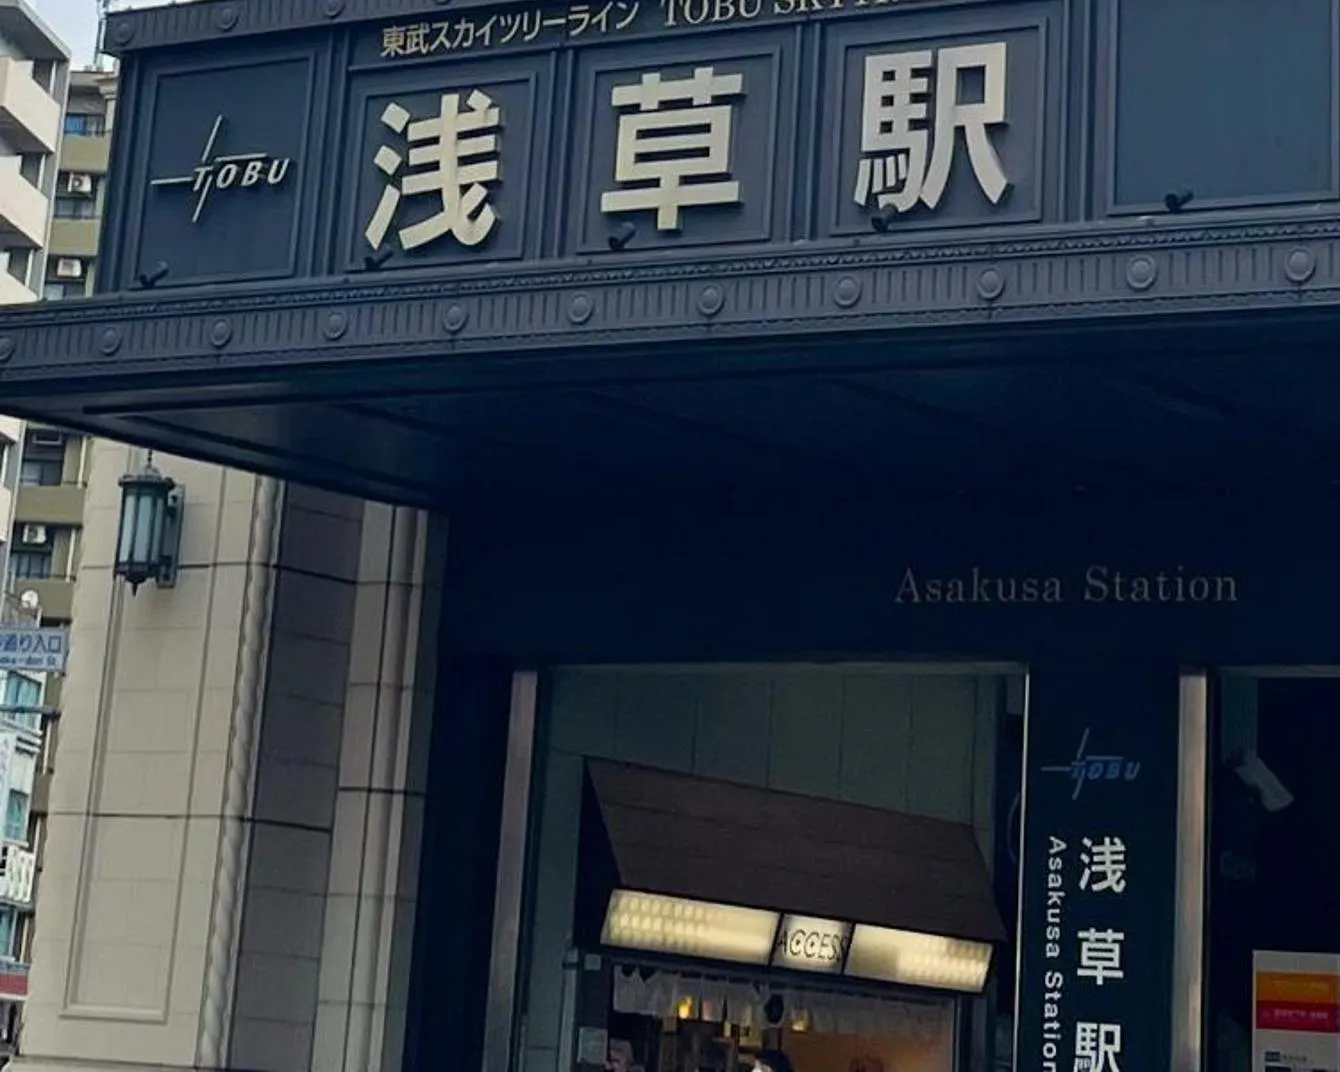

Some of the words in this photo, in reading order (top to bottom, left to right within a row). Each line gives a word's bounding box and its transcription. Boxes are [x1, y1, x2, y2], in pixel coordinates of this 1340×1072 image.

[380, 1, 639, 57] 東武スカイツリーライン
[364, 41, 1014, 252] 浅草駅
[894, 567, 1063, 604] Asakusa
[1084, 565, 1238, 603] Station
[1045, 835, 1067, 959] Asakusa
[1072, 836, 1127, 1072] 浅草駅
[1042, 969, 1065, 1072] Station
